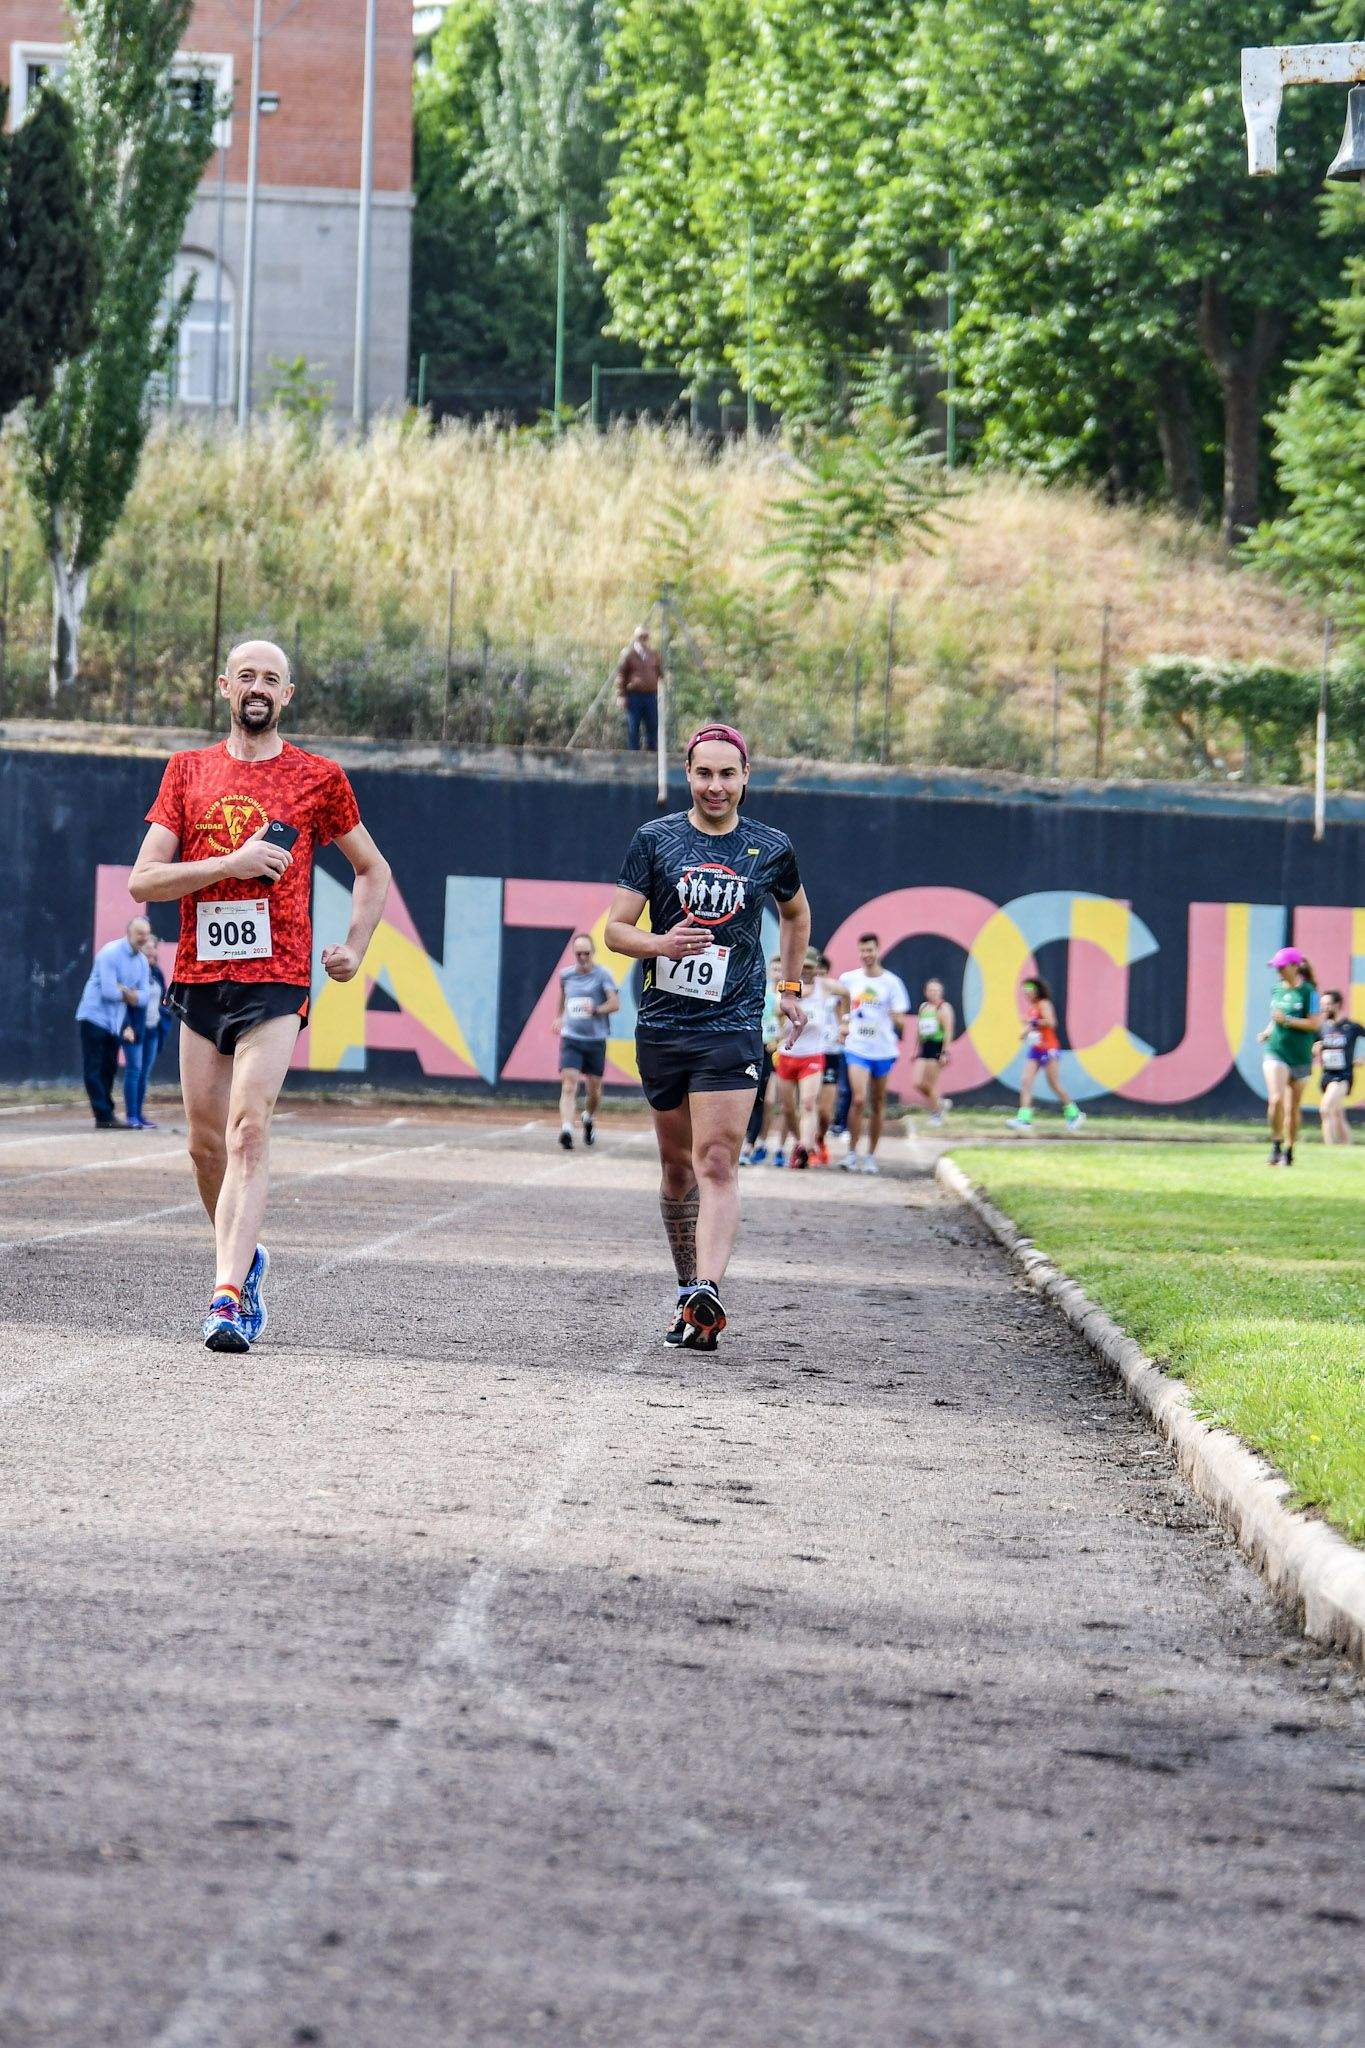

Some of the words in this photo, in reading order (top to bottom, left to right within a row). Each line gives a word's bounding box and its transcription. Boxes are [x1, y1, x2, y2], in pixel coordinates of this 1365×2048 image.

[205, 802, 221, 819] CLUB
[682, 866, 723, 874] SOSPECHOSOS
[714, 873, 748, 882] HABITUALES
[695, 910, 720, 918] RUNNERS
[208, 921, 257, 946] 908
[669, 960, 713, 985] 719
